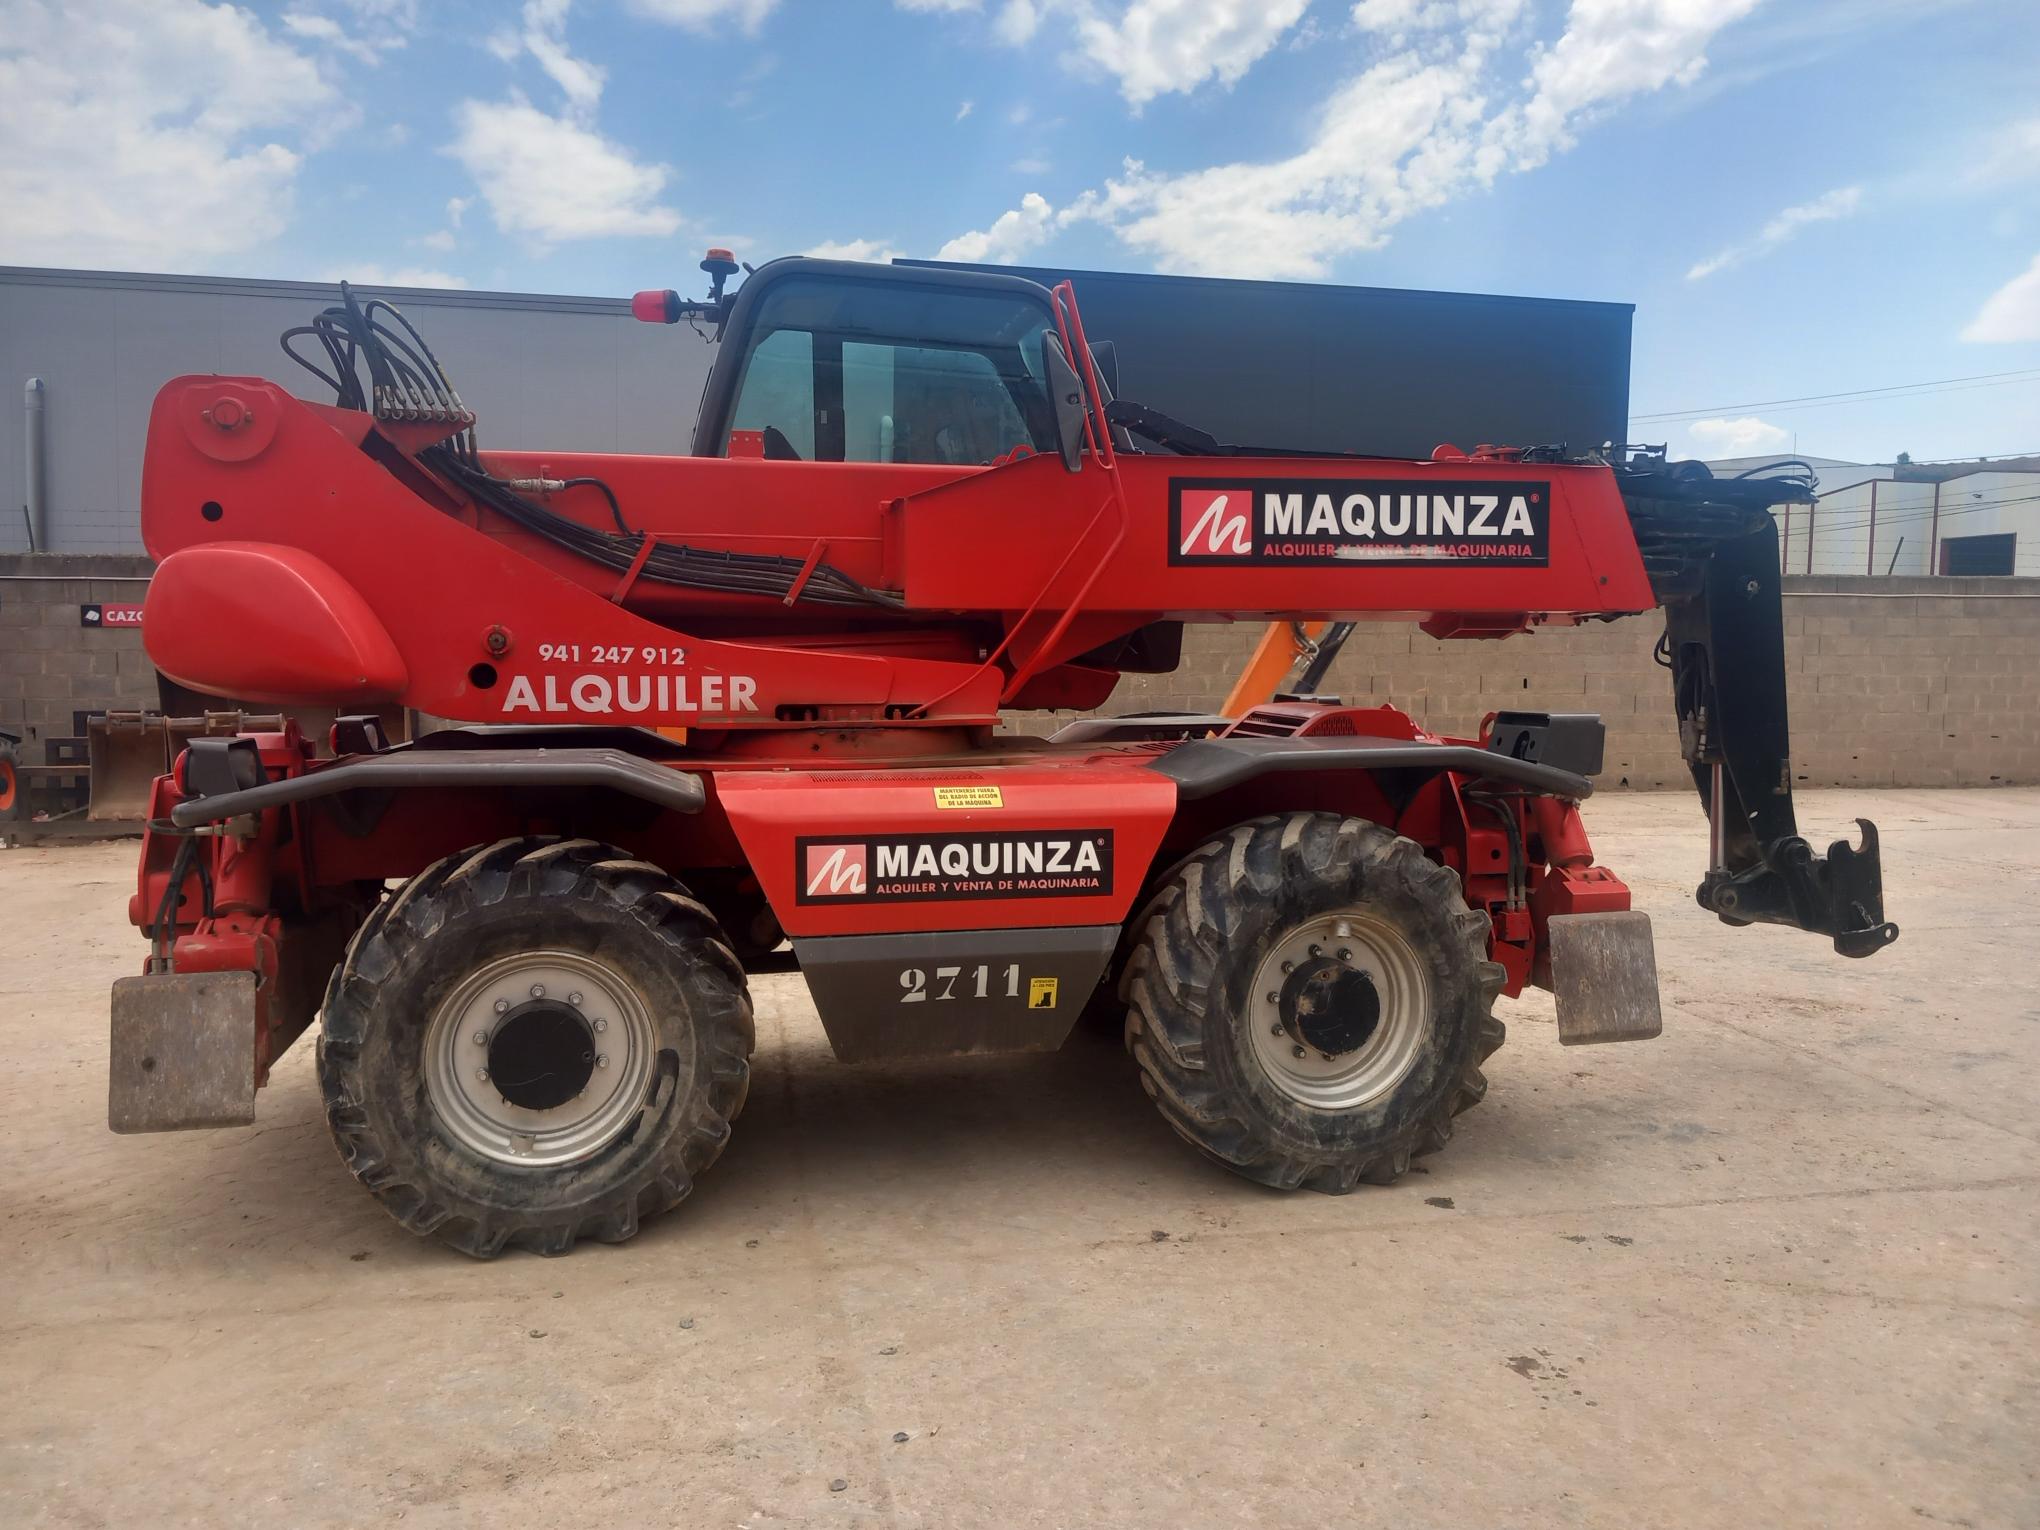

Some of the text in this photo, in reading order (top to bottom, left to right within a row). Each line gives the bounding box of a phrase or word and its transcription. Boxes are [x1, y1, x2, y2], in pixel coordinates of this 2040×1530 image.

[1264, 493, 1534, 539] MAQUINZA
[1263, 543, 1335, 556] ALQUILER
[1432, 544, 1532, 557] MAQUINARIA
[538, 643, 685, 665] 941 247 912
[501, 674, 759, 714] ALQUILER
[876, 840, 1101, 878] MAQUINZA
[876, 877, 1100, 894] ALQUILER Y VENTA DE MAQUINARIA
[899, 963, 1020, 1003] 2711
